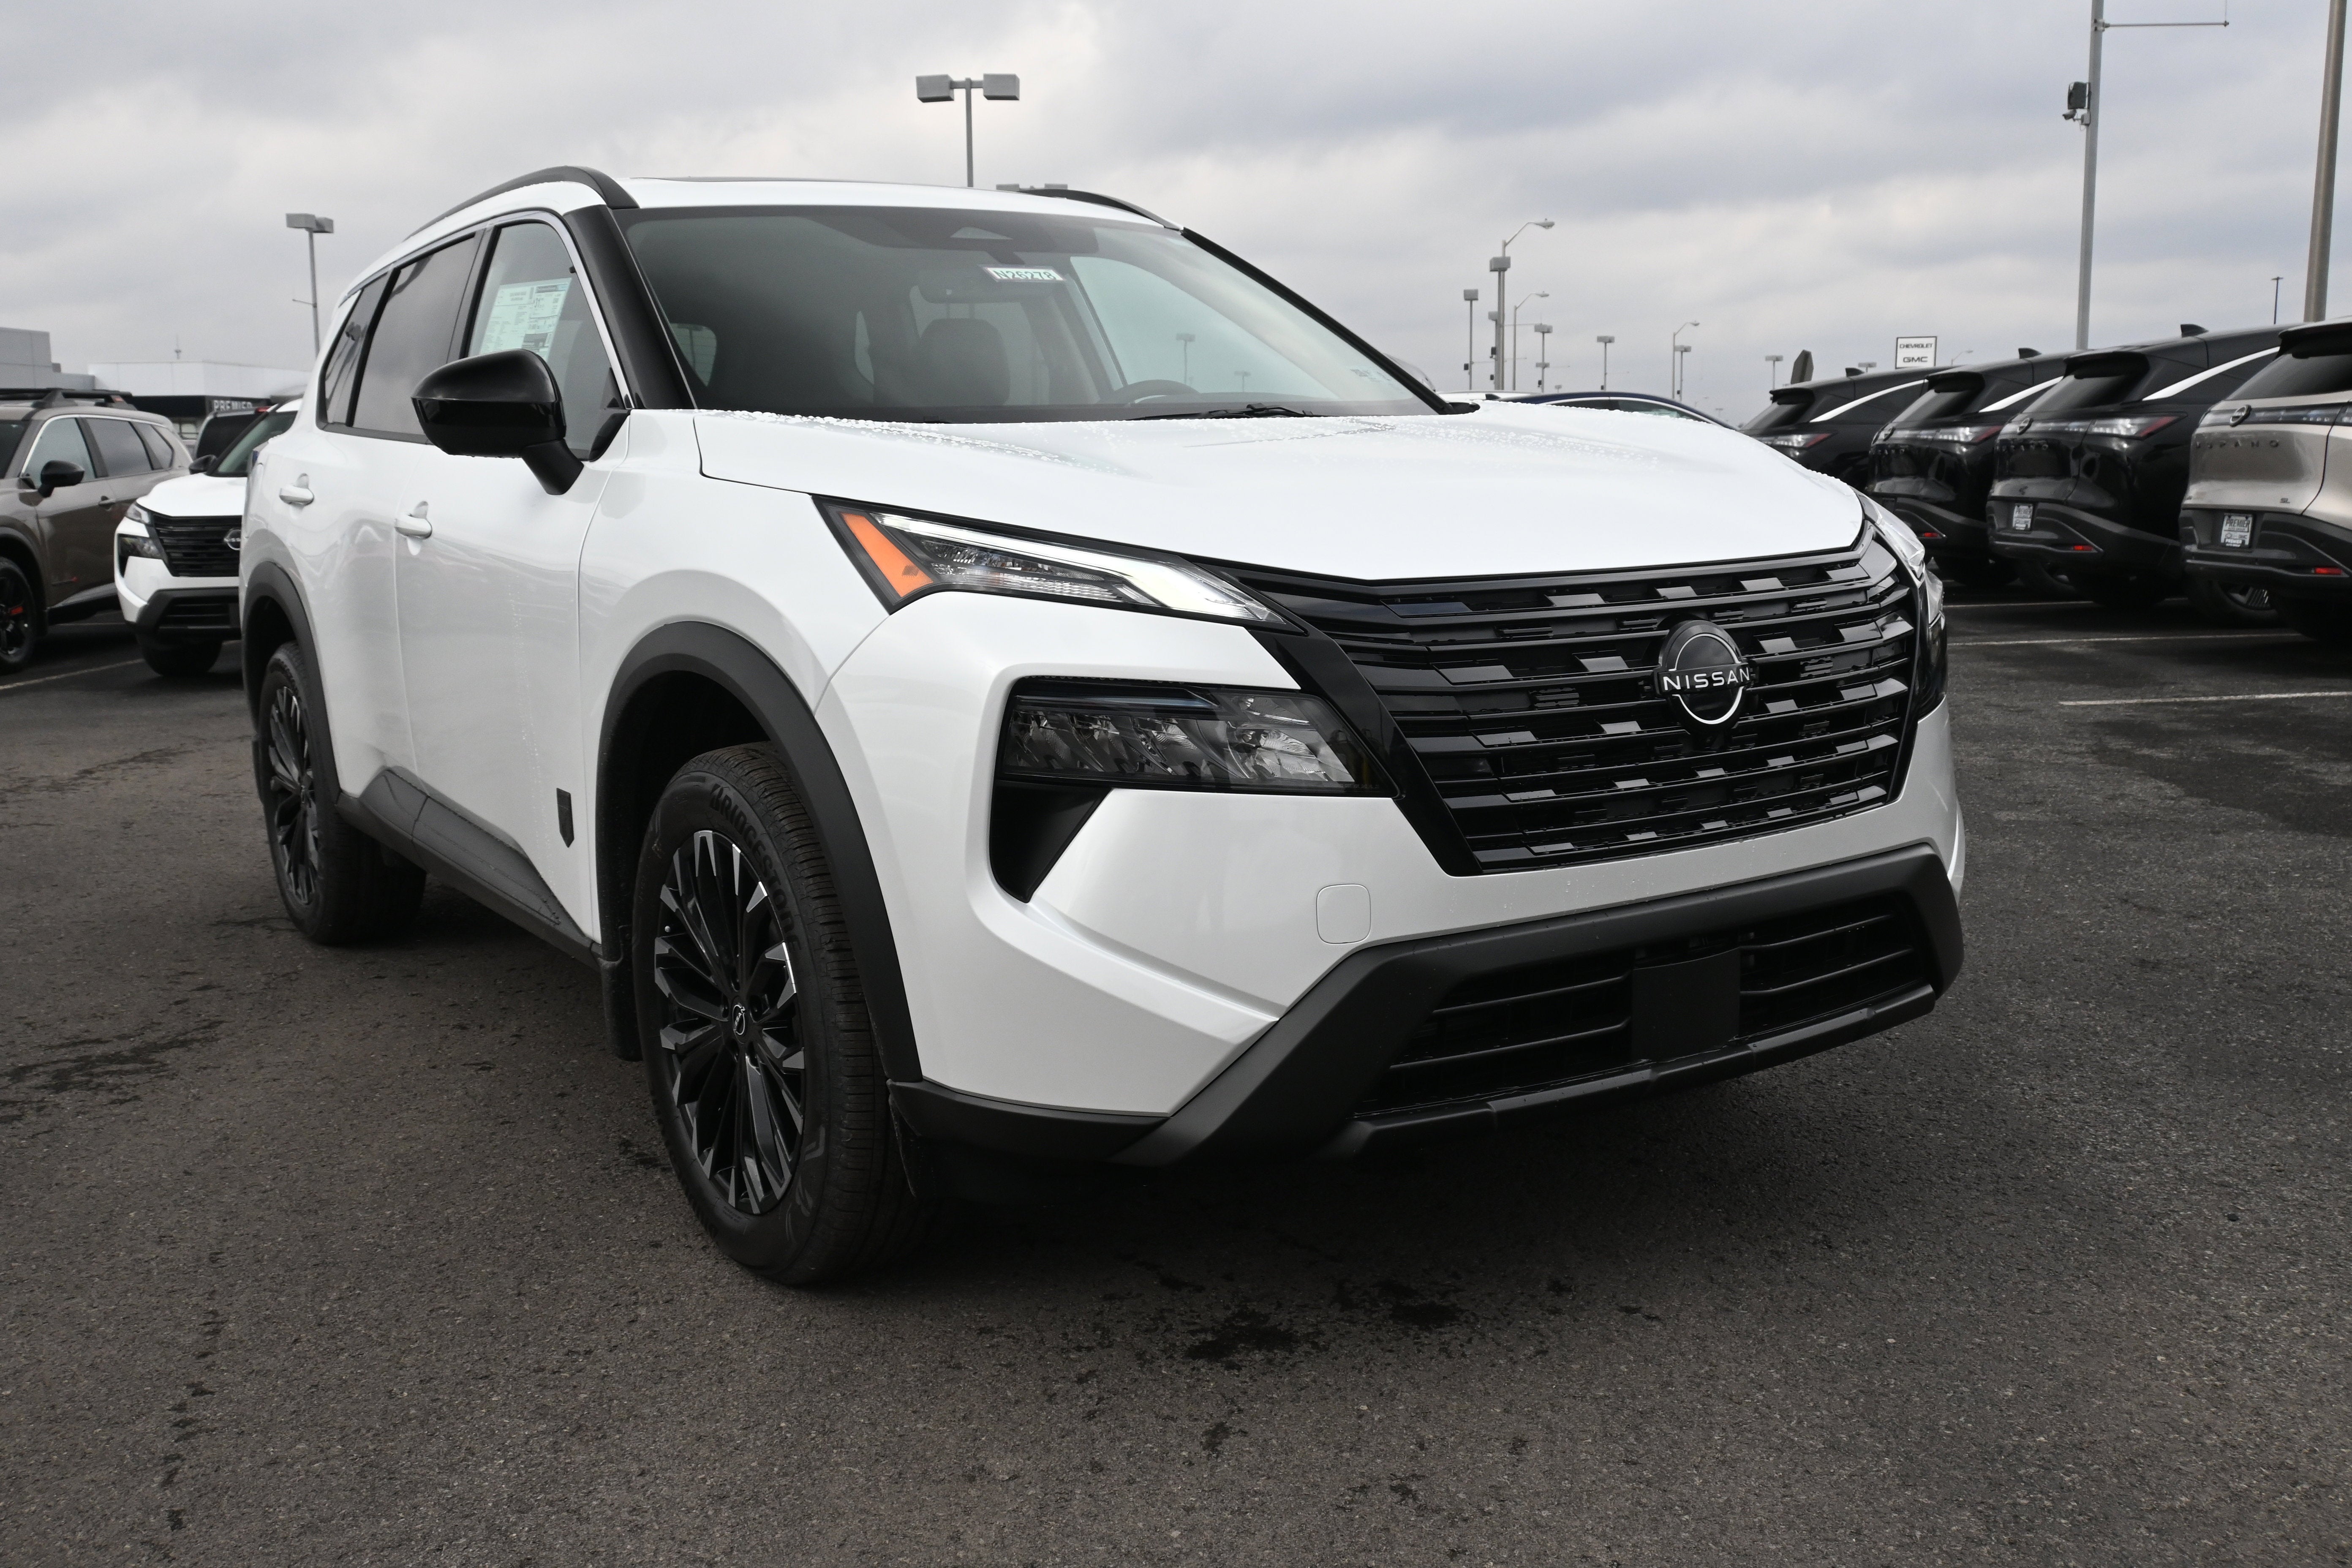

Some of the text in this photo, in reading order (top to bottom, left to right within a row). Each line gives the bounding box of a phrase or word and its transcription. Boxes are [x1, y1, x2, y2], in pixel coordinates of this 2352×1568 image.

[993, 270, 1056, 280] N26278
[2225, 518, 2250, 528] PREMIER
[1663, 667, 1750, 690] NISSAN
[710, 783, 802, 951] BRIDGESTONE
